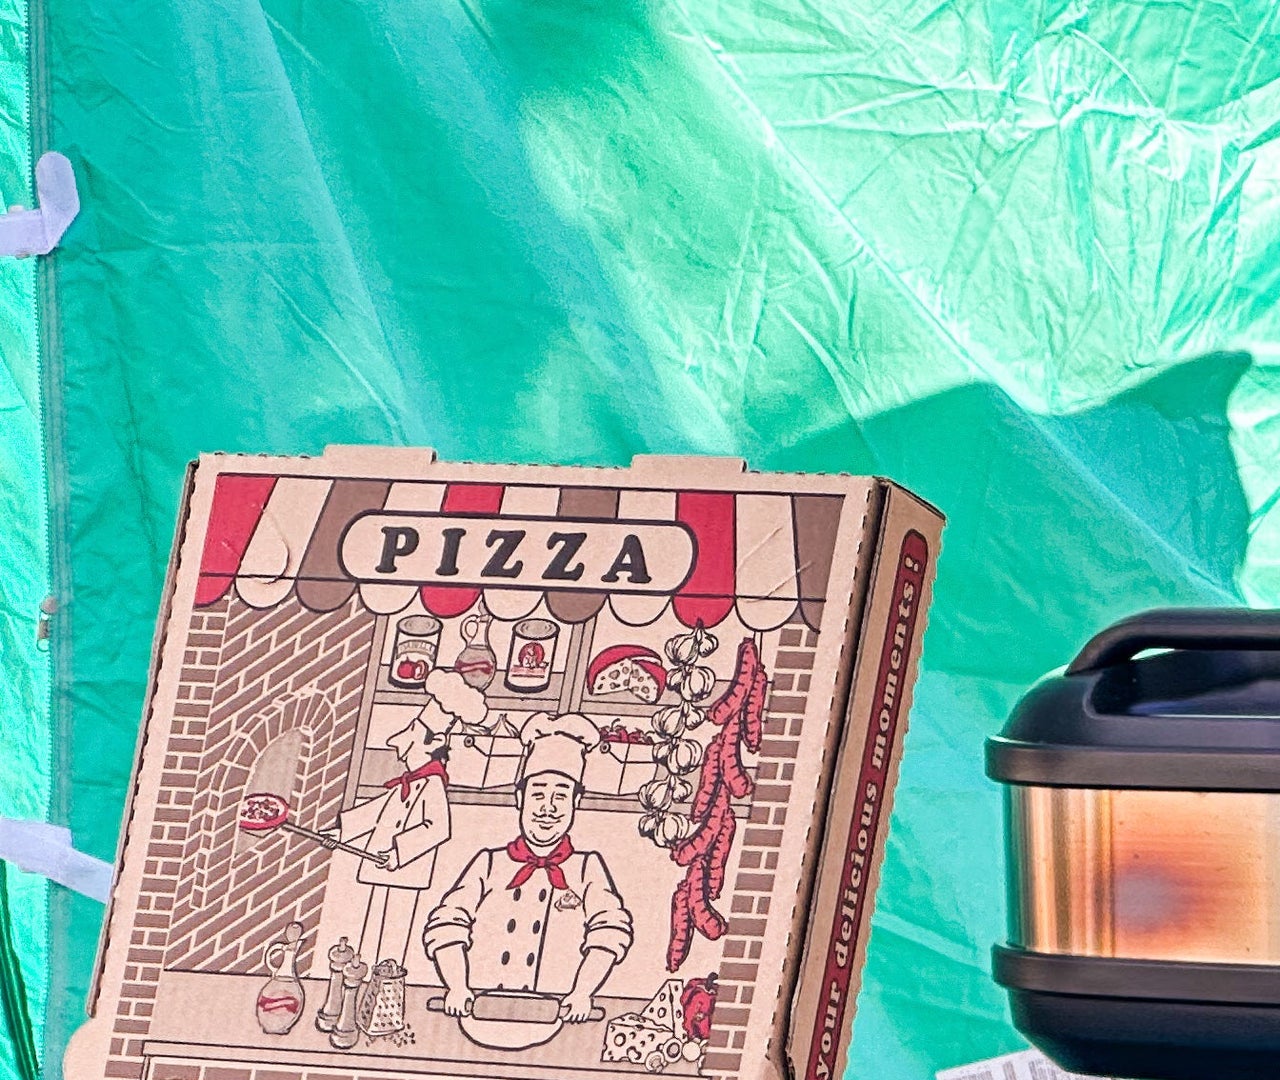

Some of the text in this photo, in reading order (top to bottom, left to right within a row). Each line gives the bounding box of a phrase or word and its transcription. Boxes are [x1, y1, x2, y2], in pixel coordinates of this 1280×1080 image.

[375, 525, 652, 585] PIZZA
[816, 981, 841, 1080] your
[835, 784, 877, 967] delicious
